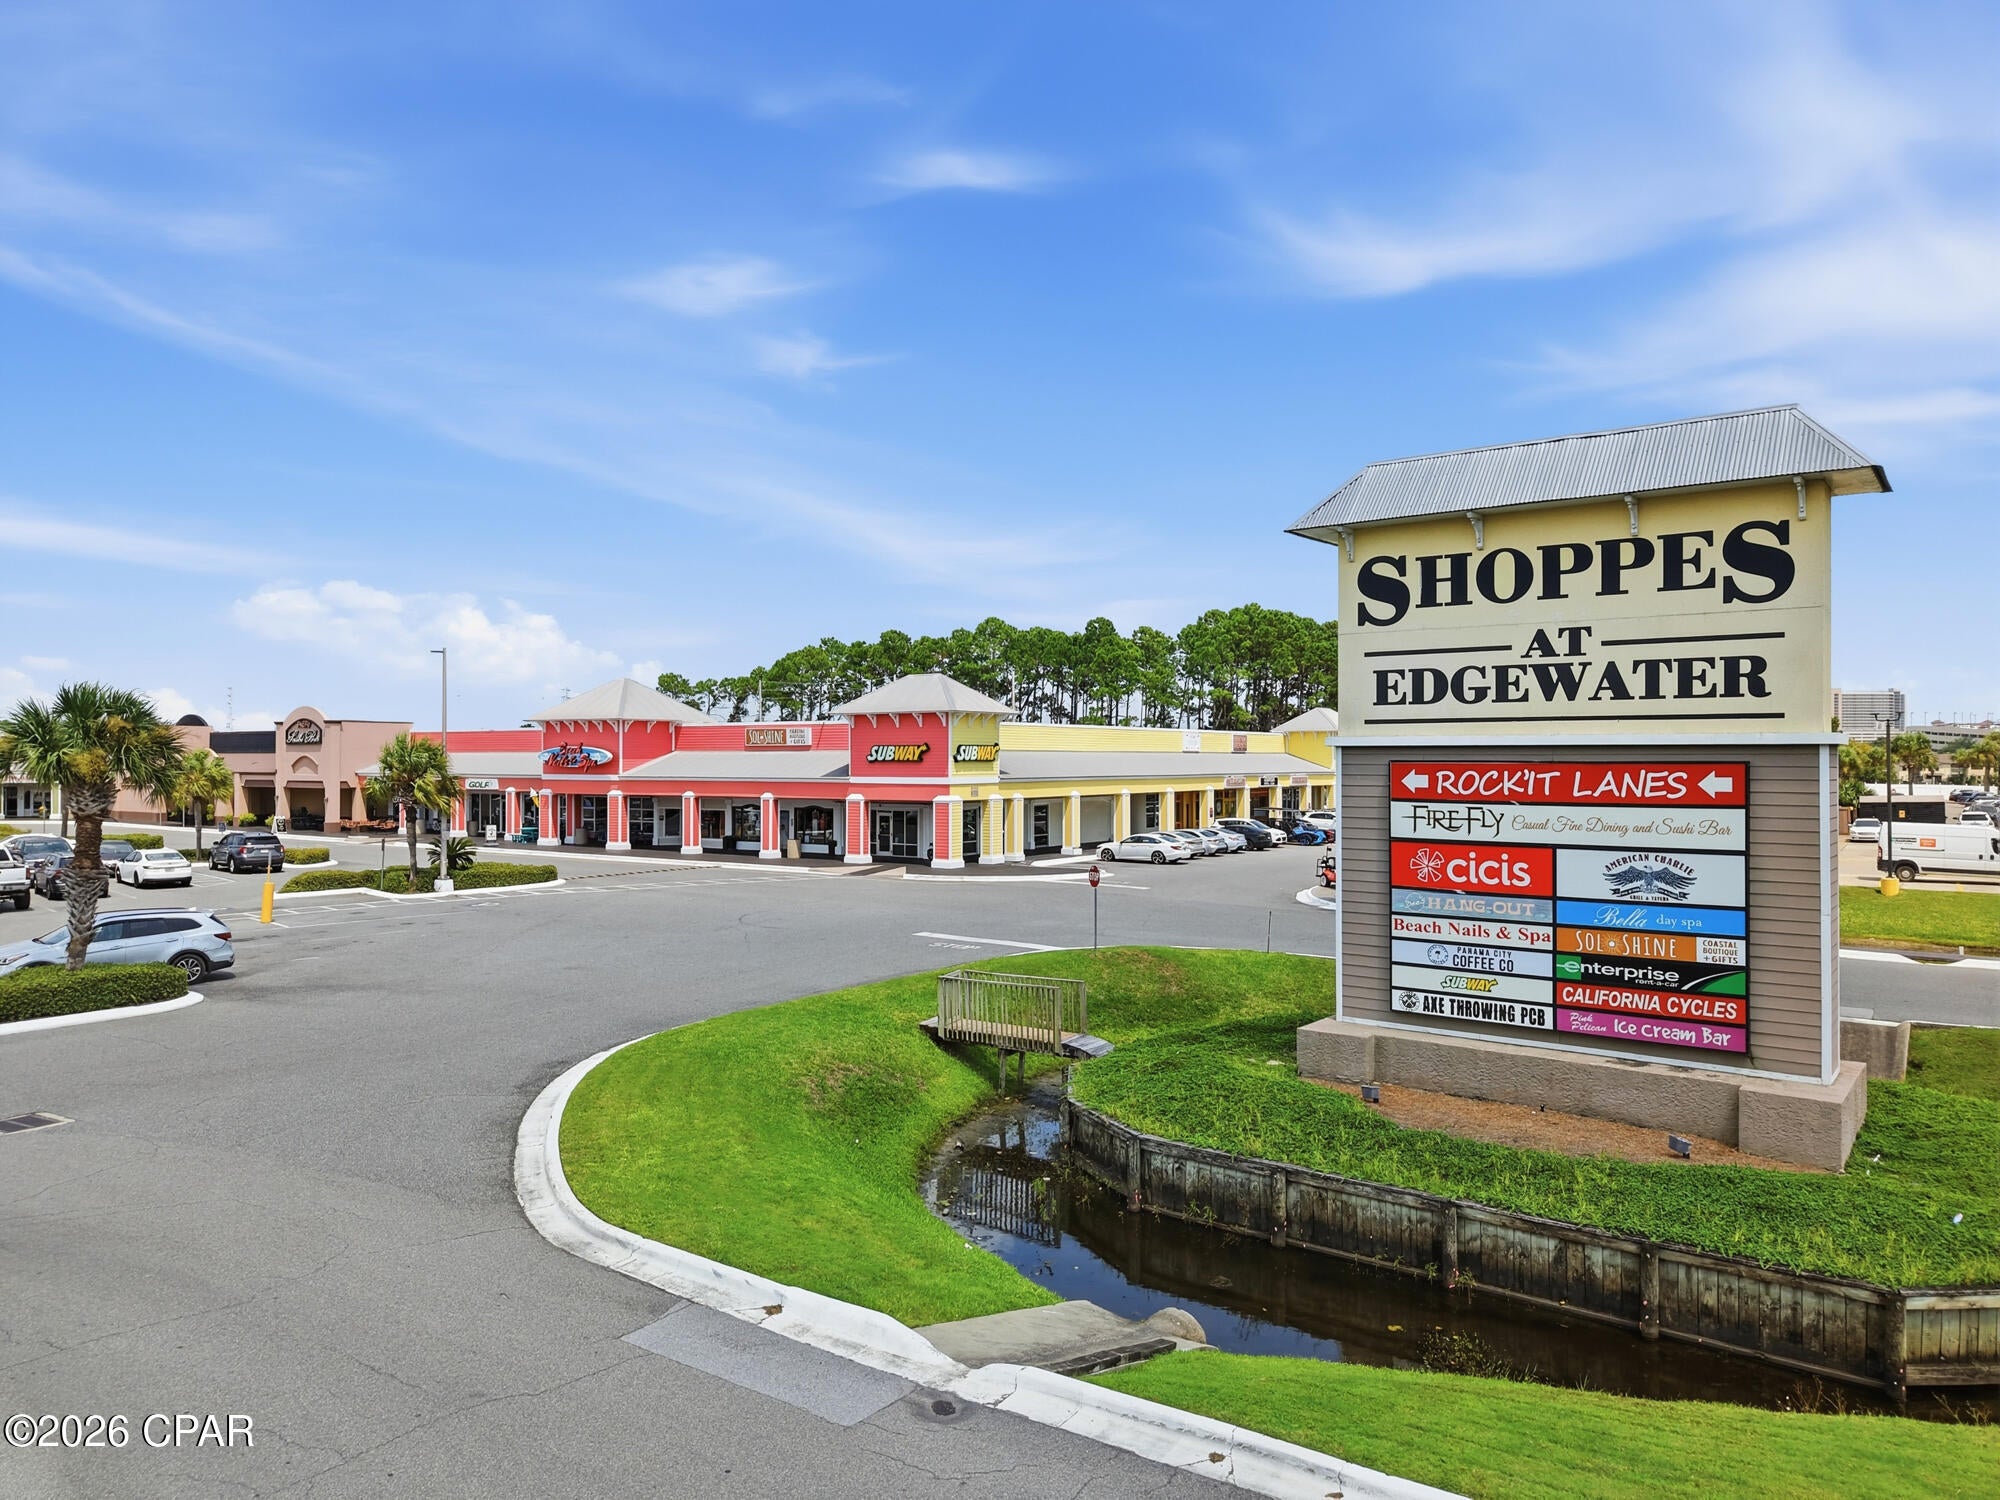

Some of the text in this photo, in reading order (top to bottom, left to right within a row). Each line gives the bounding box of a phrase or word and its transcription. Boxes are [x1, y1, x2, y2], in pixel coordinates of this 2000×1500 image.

[1357, 519, 1795, 626] SHOPPES
[1520, 625, 1592, 658] AT
[1373, 655, 1772, 706] EDGEWATER
[867, 743, 929, 762] SUBWAY
[955, 743, 1000, 762] SUBWAY
[1436, 768, 1688, 798] ROCK'IT LANES
[1511, 814, 1550, 831] Casual
[1552, 815, 1583, 832] Fine
[1585, 816, 1629, 838] Dining
[1632, 820, 1654, 833] and
[1655, 817, 1695, 836] Sushi
[1697, 819, 1733, 836] Bar
[1446, 851, 1531, 887] cicis
[1604, 853, 1695, 876] AMERICAN CHARLIE
[1593, 905, 1702, 930] Bella day spa
[1393, 918, 1551, 945] Beach Nails & Spa
[1456, 946, 1490, 956] PANAMA
[1494, 950, 1512, 958] CITY
[1576, 930, 1677, 957] SOL SHINE
[1703, 940, 1738, 949] COASTAL
[1703, 947, 1738, 956] BOUTIQUE
[1452, 954, 1494, 971] COFFEE
[1499, 960, 1514, 972] CO
[1564, 960, 1680, 982] enterprise
[1441, 975, 1498, 992] SUBWAY
[1635, 978, 1679, 988] rent-a-car
[1423, 995, 1444, 1014] AXE
[1449, 998, 1515, 1023] THROWING
[1520, 1007, 1546, 1026] PCB
[1562, 986, 1738, 1020] CALIFORNIA CYCLES
[1569, 1012, 1593, 1023] Pink
[1571, 1021, 1607, 1032] Pelican
[1701, 1027, 1732, 1046] Bar
